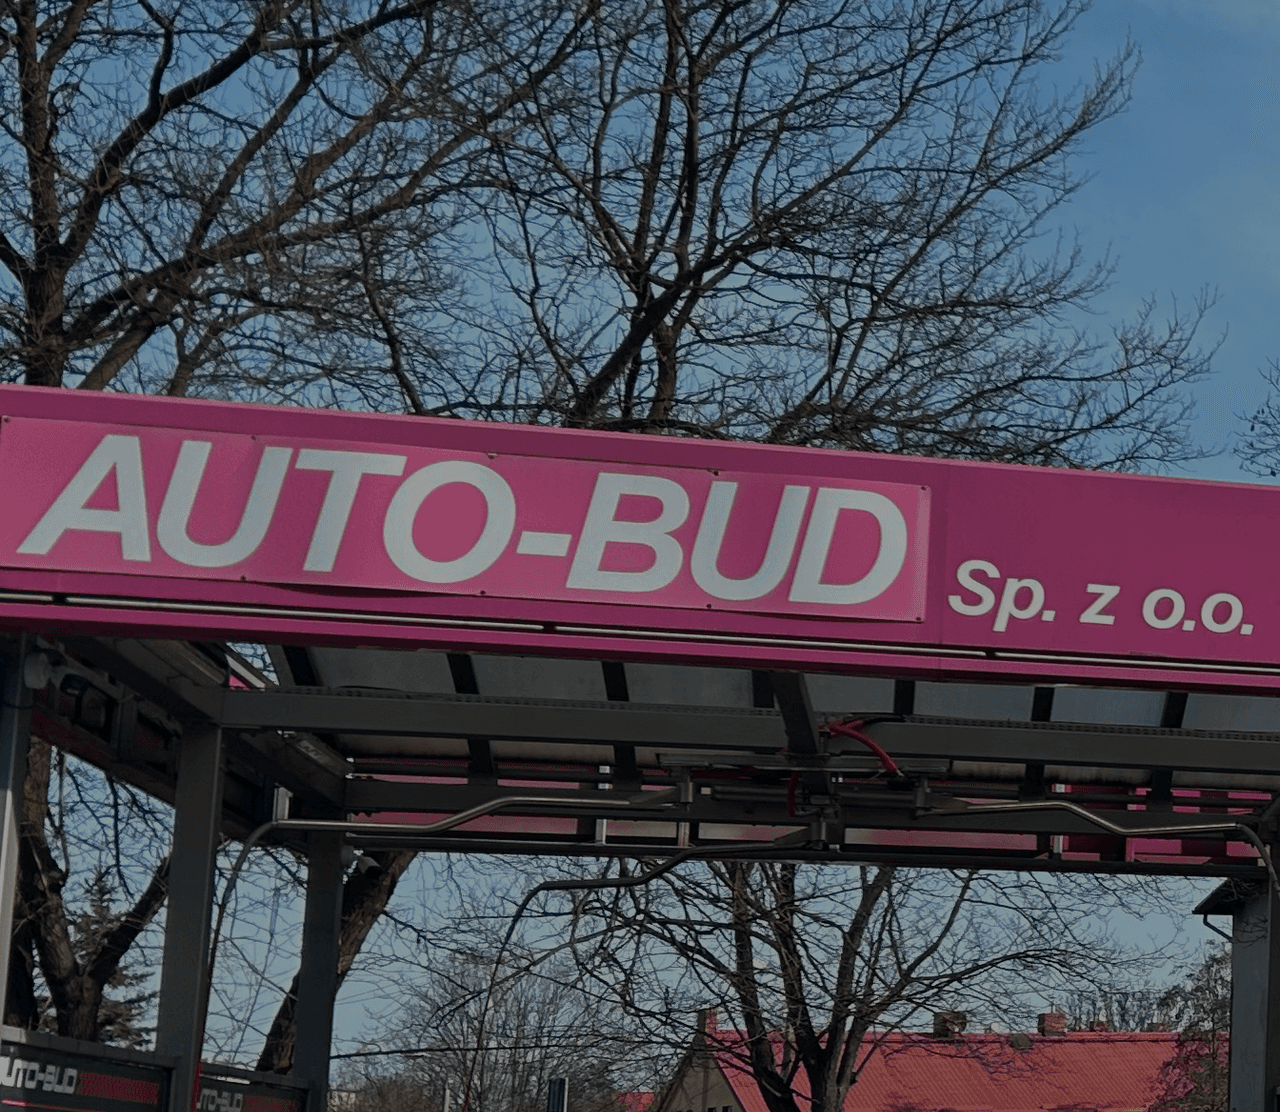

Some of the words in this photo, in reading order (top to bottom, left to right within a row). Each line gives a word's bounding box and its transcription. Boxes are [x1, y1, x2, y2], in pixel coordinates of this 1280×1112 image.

[16, 433, 909, 606] AUTO-BUD
[948, 559, 1056, 632] Sp.
[1079, 583, 1121, 625] z
[1142, 588, 1254, 635] o.o.
[0, 1055, 78, 1095] UTO-BUD
